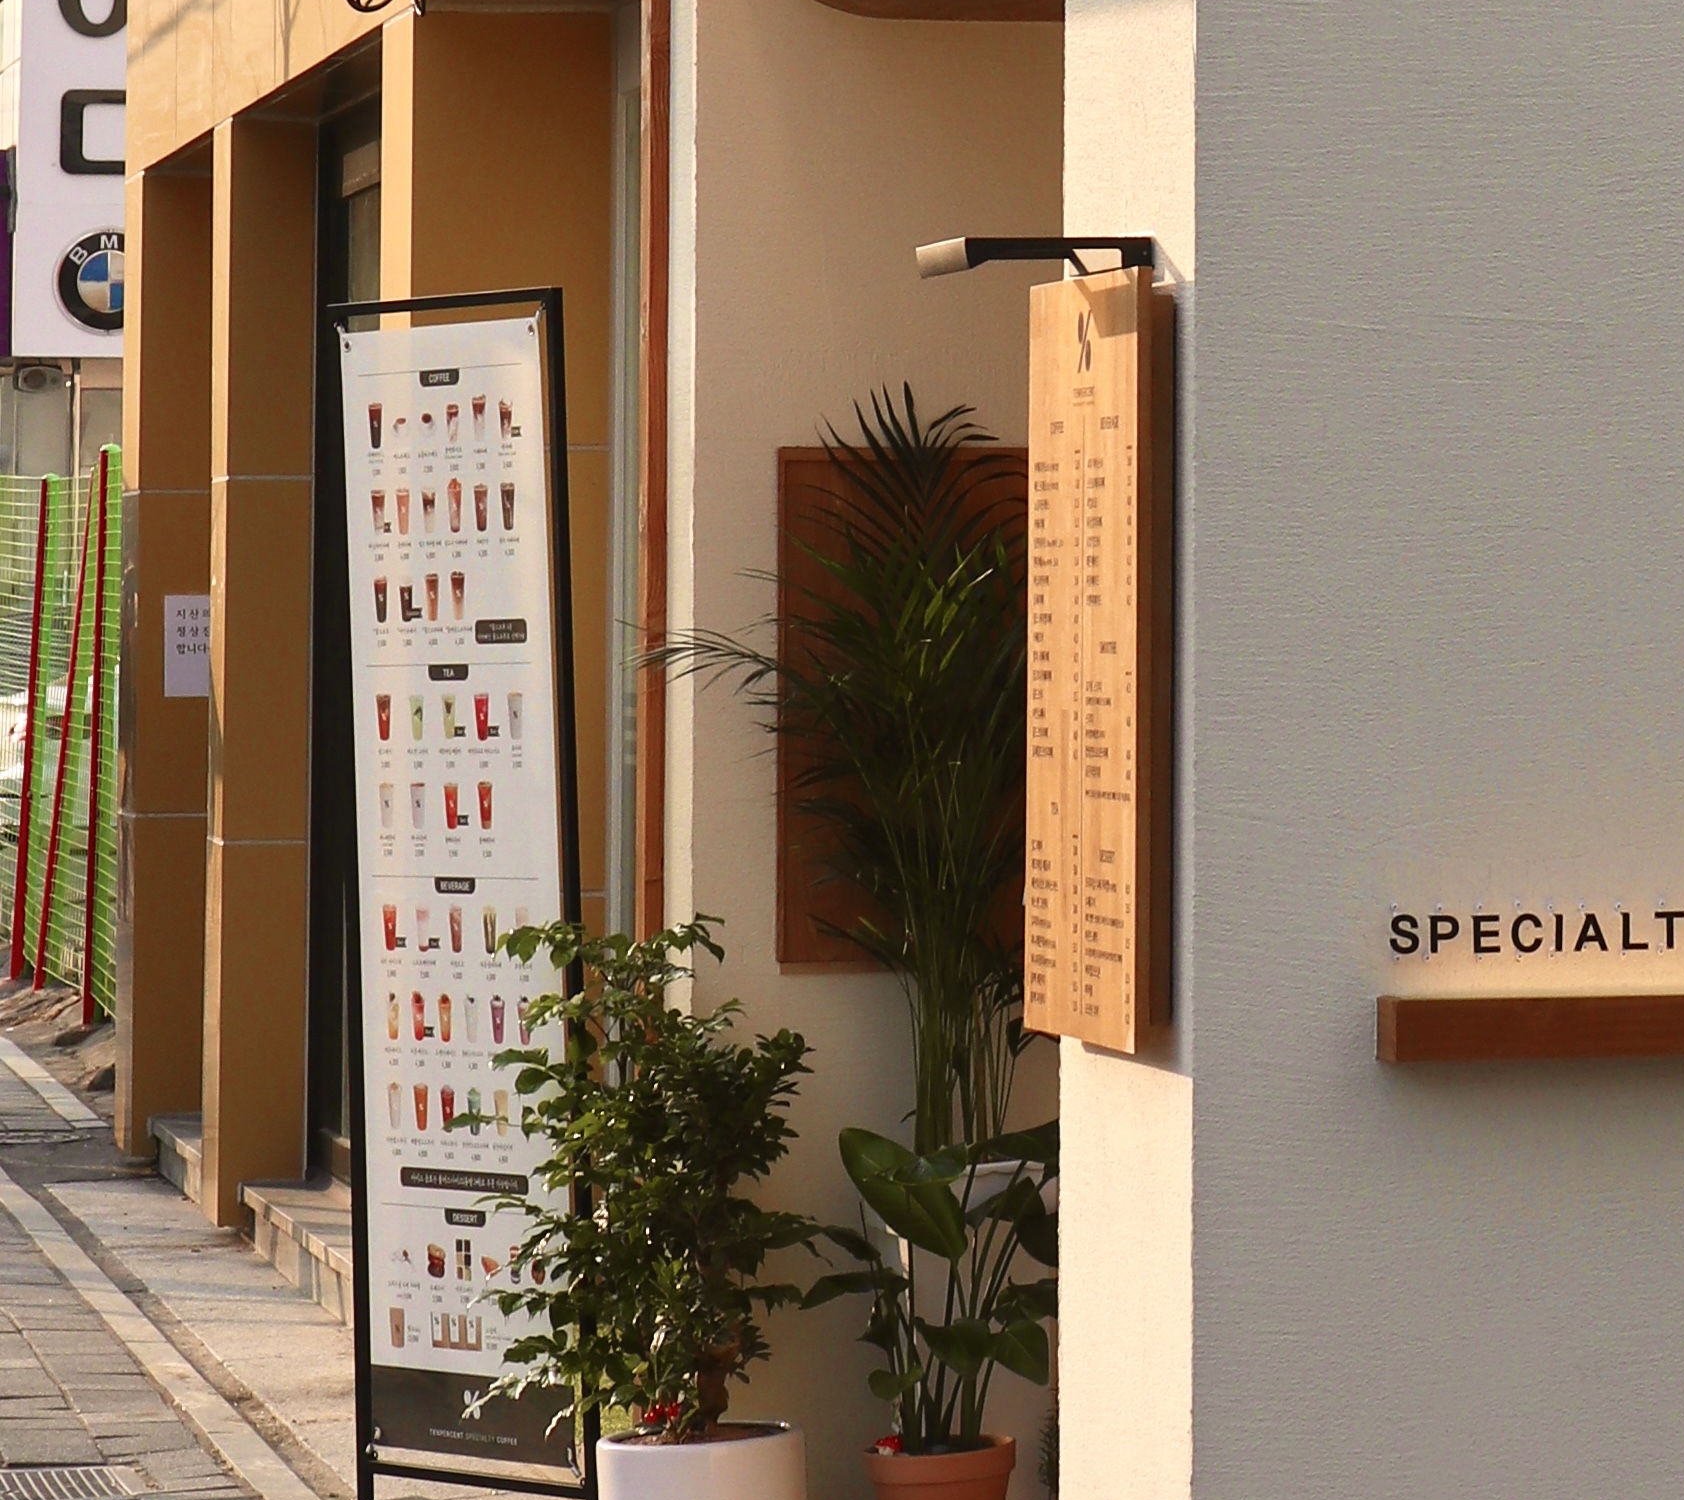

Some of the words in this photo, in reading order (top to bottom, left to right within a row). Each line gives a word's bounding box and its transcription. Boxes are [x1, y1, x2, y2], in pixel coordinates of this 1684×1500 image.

[428, 372, 451, 384] COFFEE
[442, 668, 455, 678] TEA
[440, 881, 471, 893] BEVERAGE
[452, 1213, 478, 1225] DESSERT
